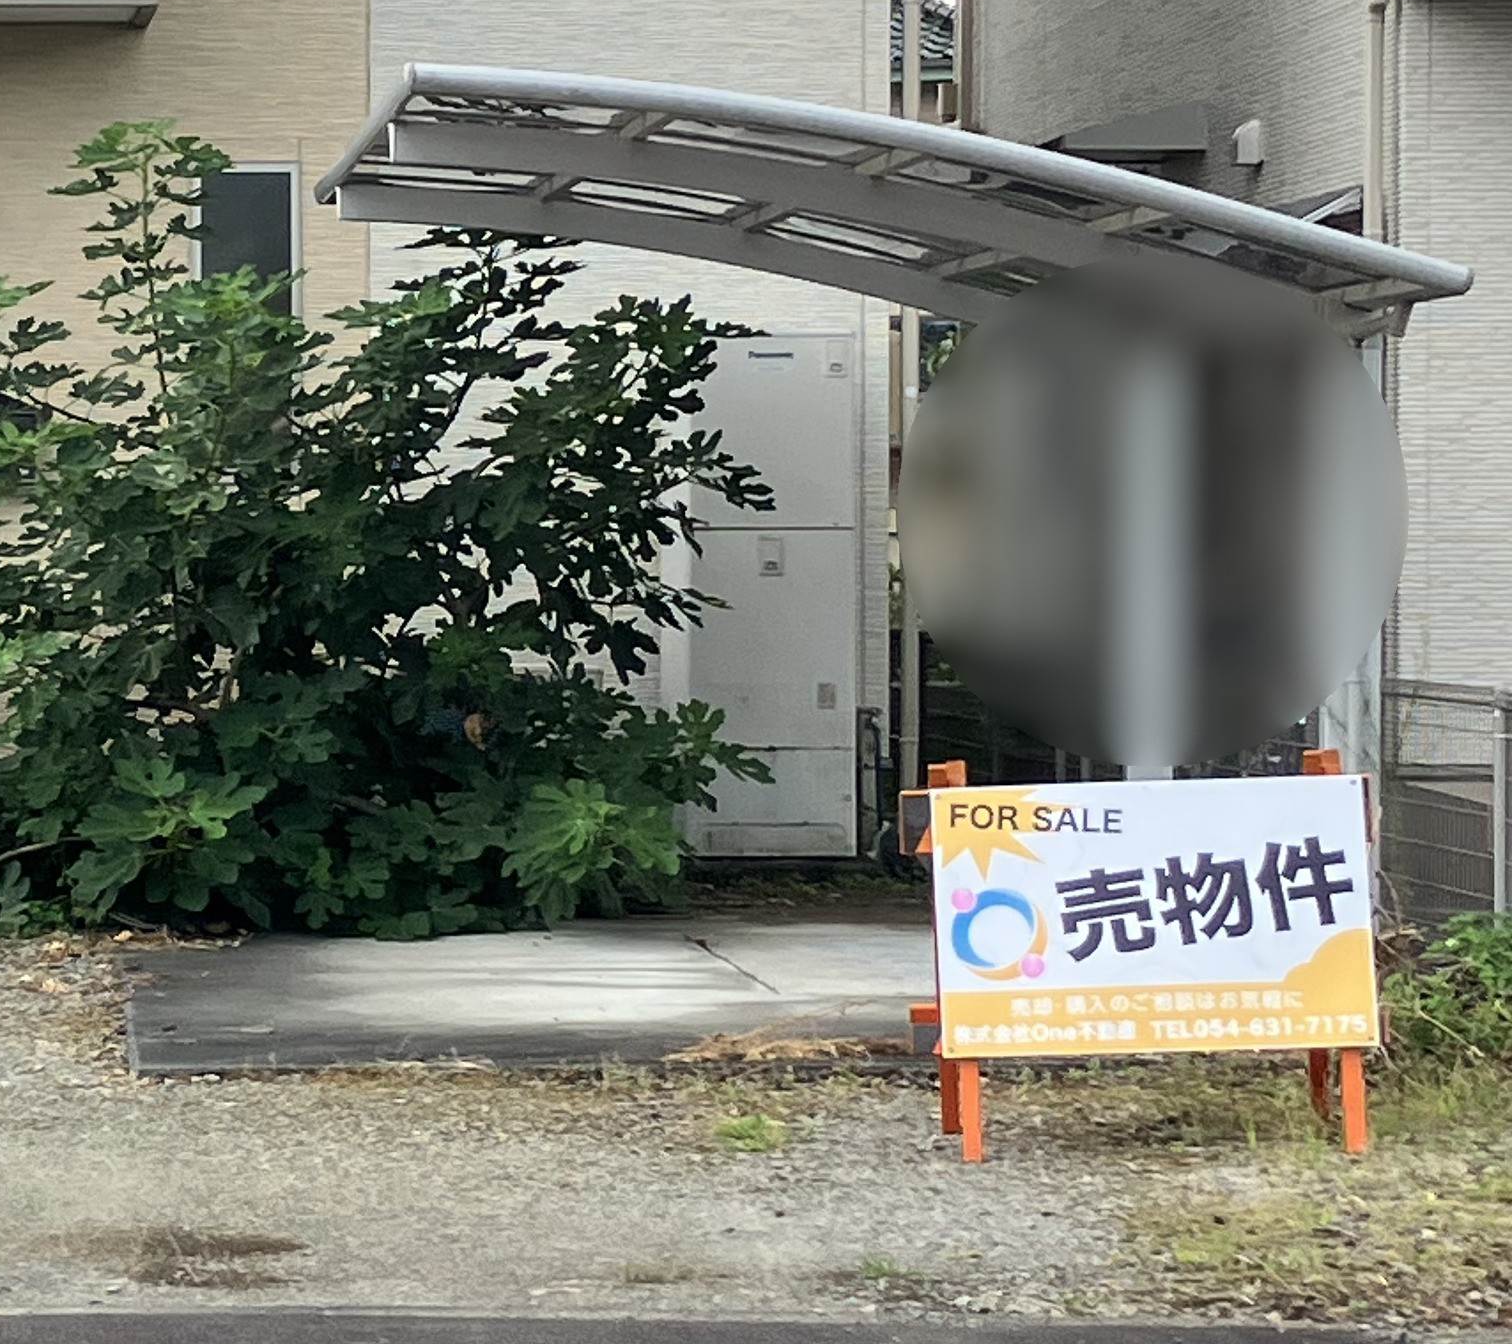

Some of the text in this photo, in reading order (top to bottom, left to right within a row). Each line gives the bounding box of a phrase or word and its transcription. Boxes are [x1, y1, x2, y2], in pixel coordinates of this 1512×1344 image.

[950, 803, 1123, 834] FOR SALE
[1055, 836, 1353, 962] 売物件
